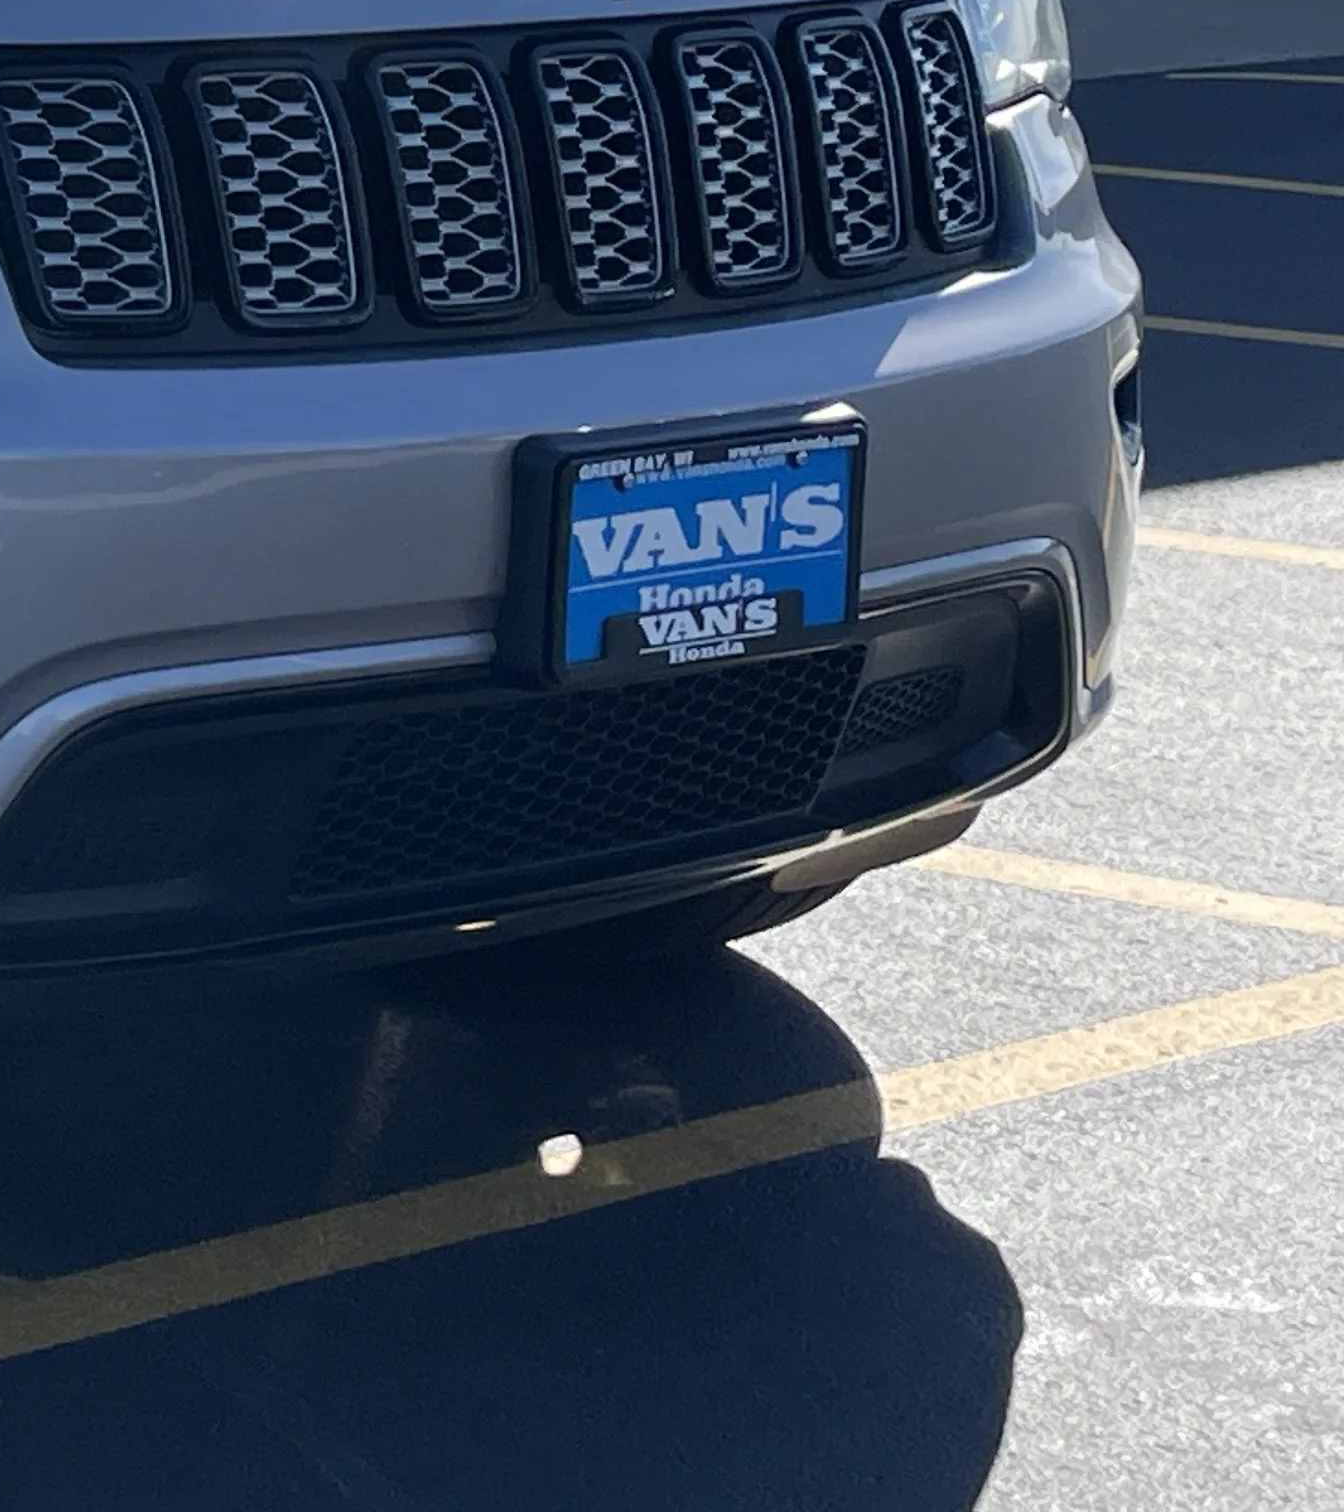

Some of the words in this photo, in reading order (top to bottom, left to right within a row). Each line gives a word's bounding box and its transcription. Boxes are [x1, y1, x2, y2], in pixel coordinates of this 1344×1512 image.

[571, 481, 845, 579] VAN'S
[638, 573, 766, 613] Honda
[638, 598, 778, 647] VAN'S
[668, 639, 746, 665] Honda
